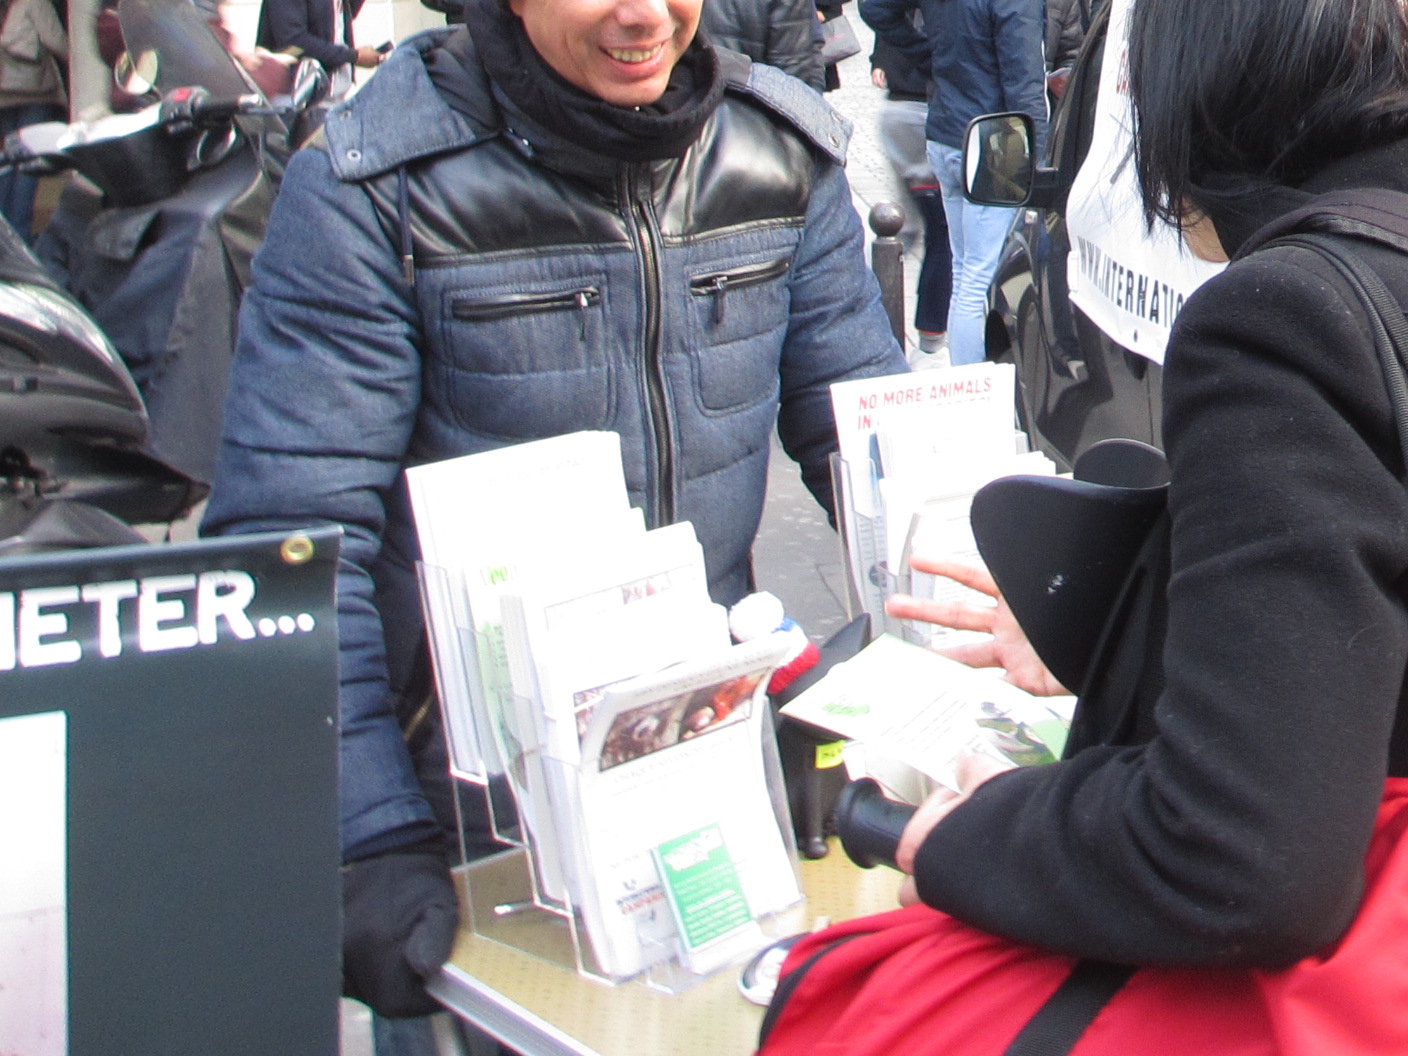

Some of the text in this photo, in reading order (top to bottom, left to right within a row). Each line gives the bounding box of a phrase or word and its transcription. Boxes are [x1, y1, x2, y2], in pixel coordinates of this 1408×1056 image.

[858, 377, 992, 411] NO MORE ANIMALS
[857, 414, 872, 431] IN
